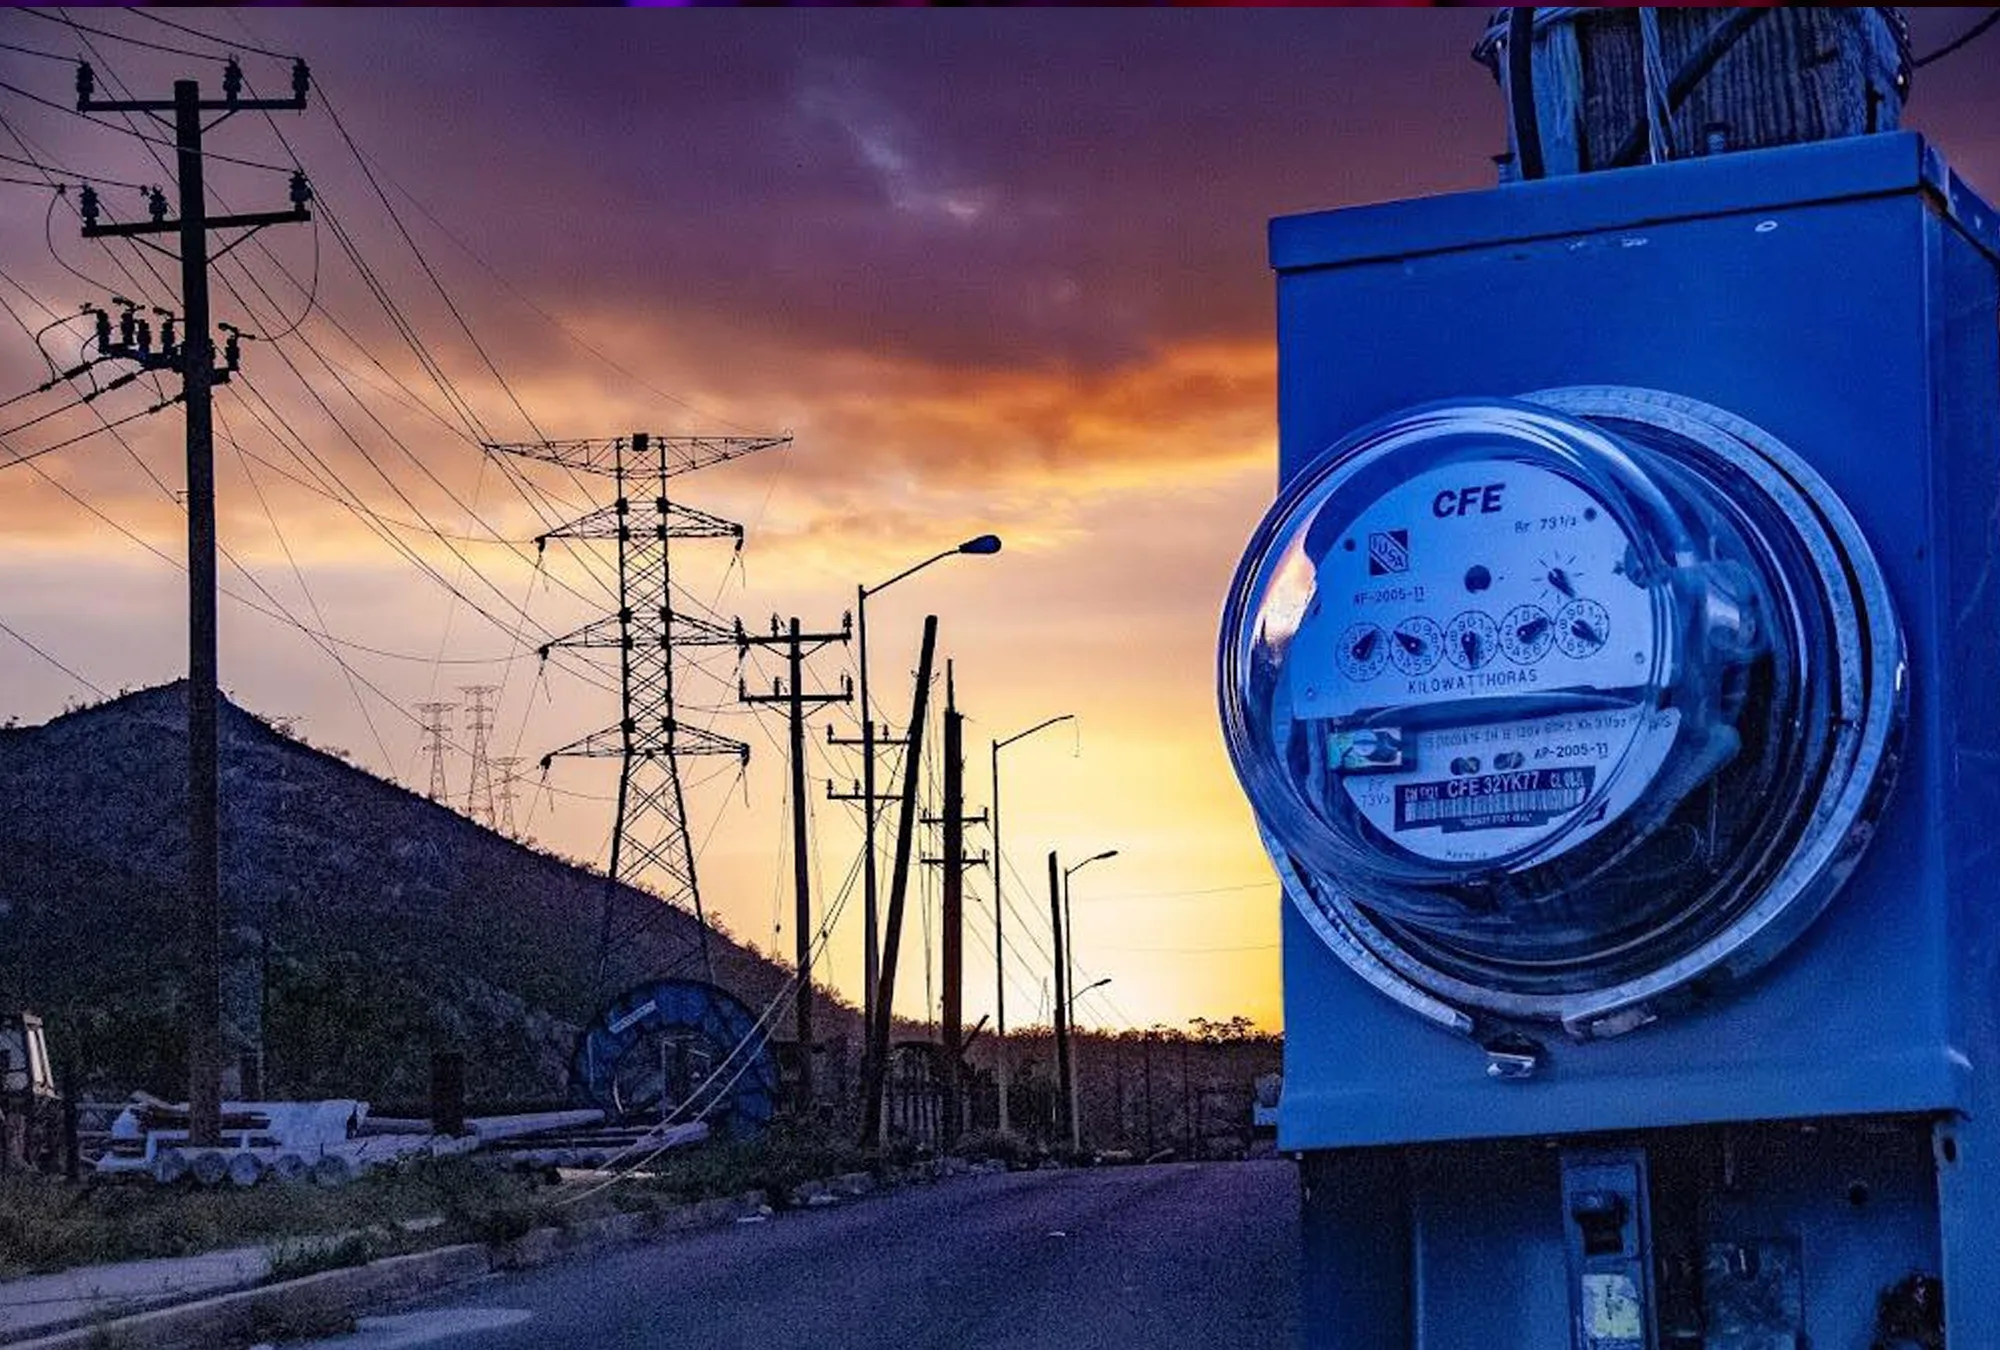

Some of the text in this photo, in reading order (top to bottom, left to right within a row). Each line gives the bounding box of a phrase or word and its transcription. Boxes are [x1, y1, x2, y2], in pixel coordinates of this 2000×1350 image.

[1433, 483, 1506, 518] CFE
[1408, 669, 1538, 693] KILOWATTHORAS
[1447, 778, 1480, 799] CFE
[1484, 772, 1539, 794] 32YK77
